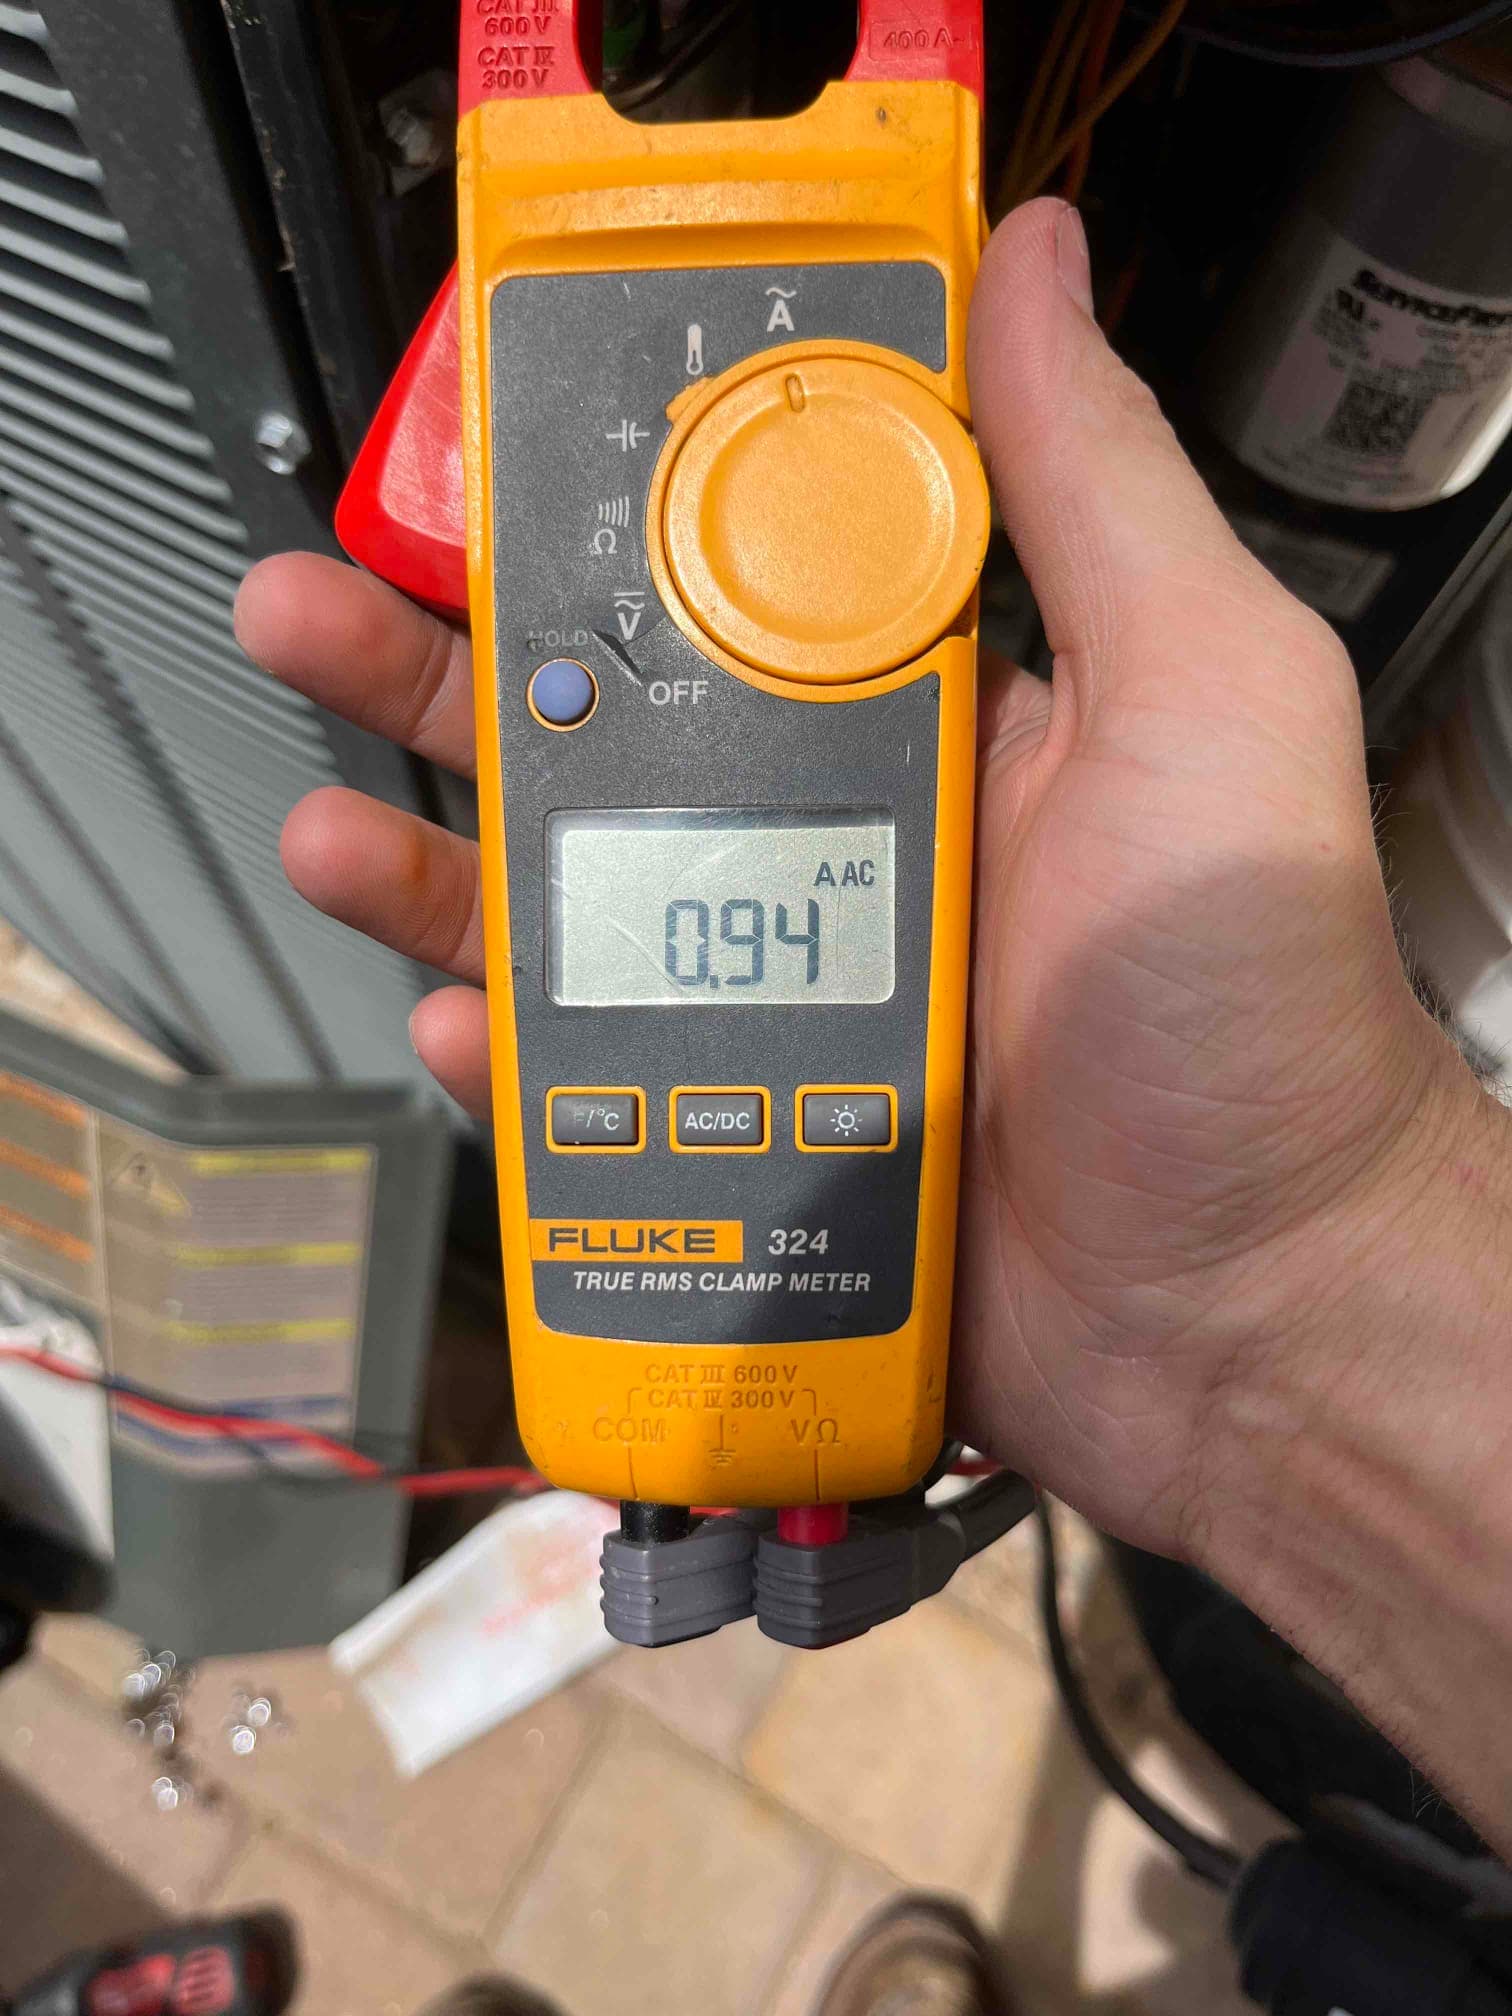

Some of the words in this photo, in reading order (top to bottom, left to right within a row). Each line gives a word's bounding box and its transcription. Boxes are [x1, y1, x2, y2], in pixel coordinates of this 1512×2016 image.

[485, 16, 530, 36] 600
[533, 15, 552, 35] V
[883, 29, 930, 49] 400
[477, 46, 530, 66] CAT
[533, 46, 555, 65] IV
[482, 69, 528, 89] 300
[531, 68, 549, 88] V
[528, 629, 589, 647] HOLD
[649, 680, 708, 705] OFF
[814, 861, 835, 887] A
[841, 859, 875, 886] AC
[665, 899, 820, 988] 0.94
[684, 1112, 751, 1131] AC/DC
[549, 1228, 716, 1254] FLUKE
[768, 1229, 829, 1255] 324
[573, 1272, 635, 1292] TRUE
[640, 1272, 693, 1292] RMS
[699, 1272, 783, 1293] CLAMP
[788, 1273, 871, 1293] METER
[646, 1364, 696, 1384] CAT
[700, 1364, 725, 1384] III
[734, 1364, 777, 1384] 600
[783, 1364, 798, 1384] V
[648, 1390, 698, 1409] CAT
[704, 1389, 723, 1409] IV
[731, 1390, 774, 1409] 300
[779, 1390, 795, 1409] V
[593, 1417, 666, 1442] COM
